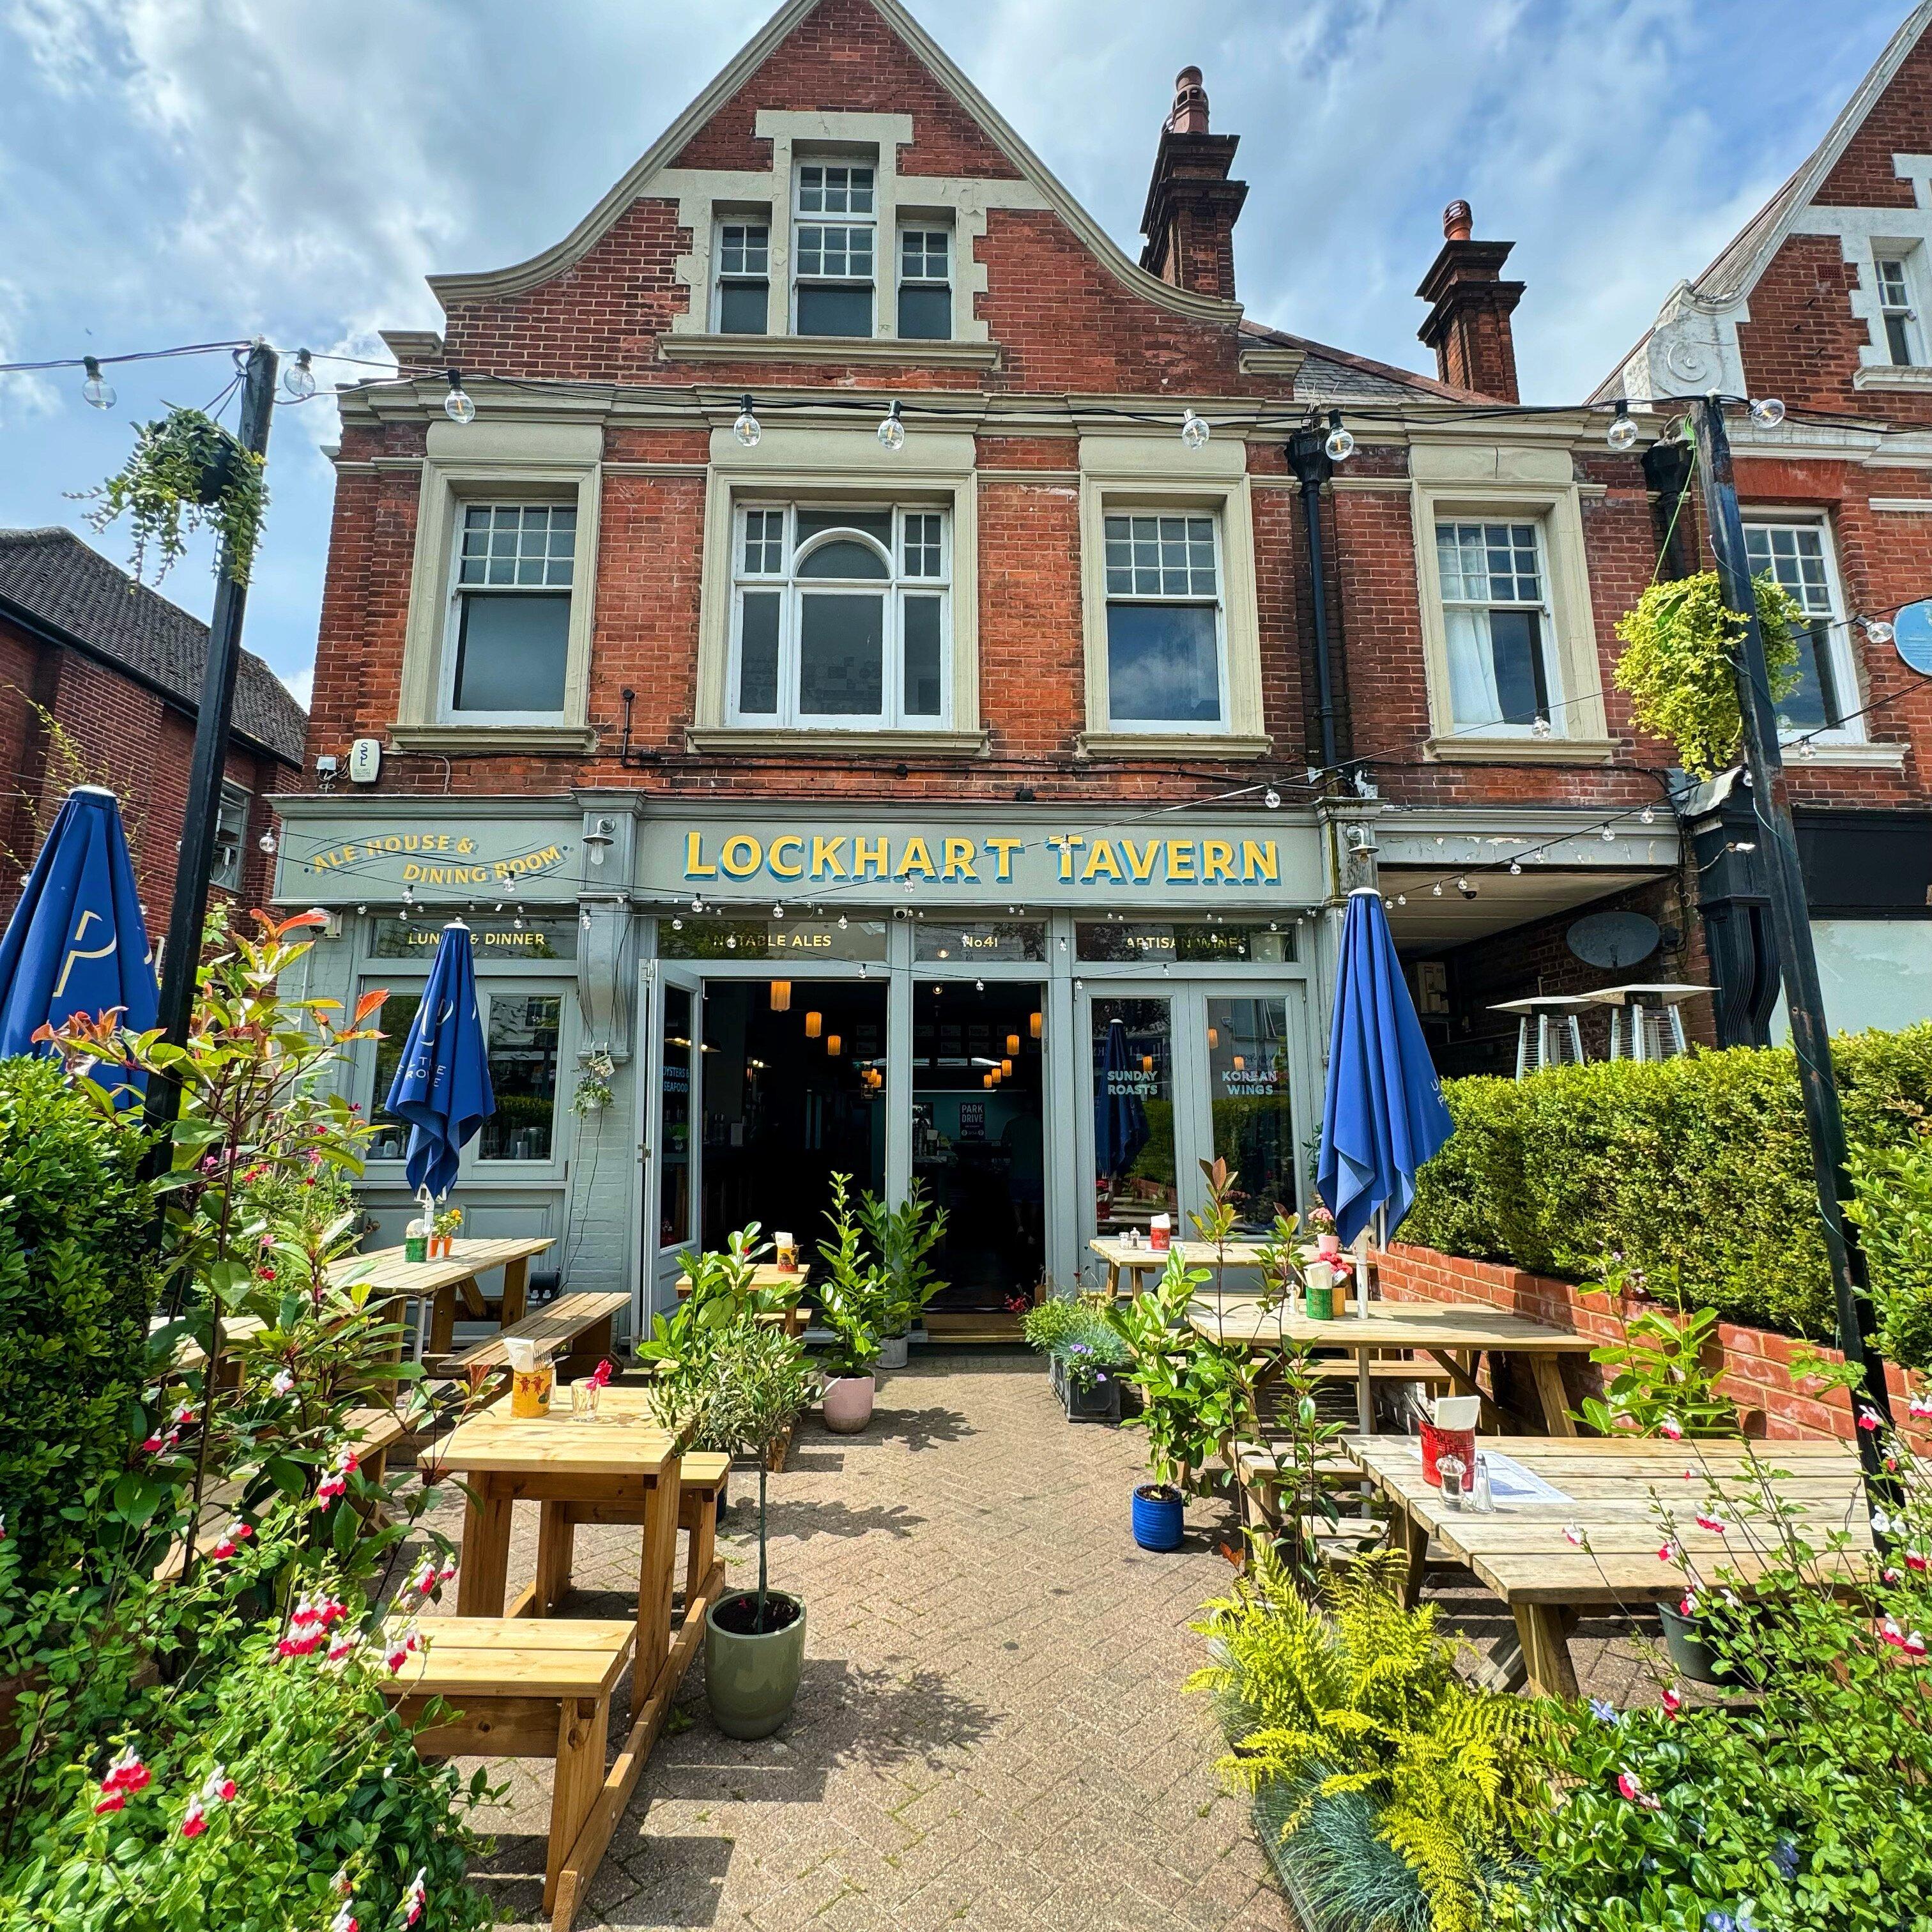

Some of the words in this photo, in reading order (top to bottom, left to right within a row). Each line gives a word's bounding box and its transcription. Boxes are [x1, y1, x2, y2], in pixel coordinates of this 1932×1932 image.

[314, 846, 360, 873] ALE
[366, 834, 451, 856] HOUSE
[457, 837, 475, 854] &
[684, 831, 1024, 884] LOCKHART
[1045, 835, 1281, 886] TAVERN
[403, 864, 488, 884] DINING
[494, 845, 562, 880] ROOM
[408, 933, 440, 945] LUN
[485, 933, 544, 945] DINNER
[713, 935, 786, 947] NTABLE
[792, 935, 832, 947] ALES
[1107, 1070, 1158, 1082] SUNDAY
[1221, 1071, 1278, 1082] KOREAN
[664, 1081, 689, 1092] SEAFOOD
[1107, 1084, 1158, 1095] ROASTS
[1227, 1084, 1274, 1095] WINGS
[962, 1104, 983, 1113] PARK
[962, 1114, 984, 1123] DRIVE
